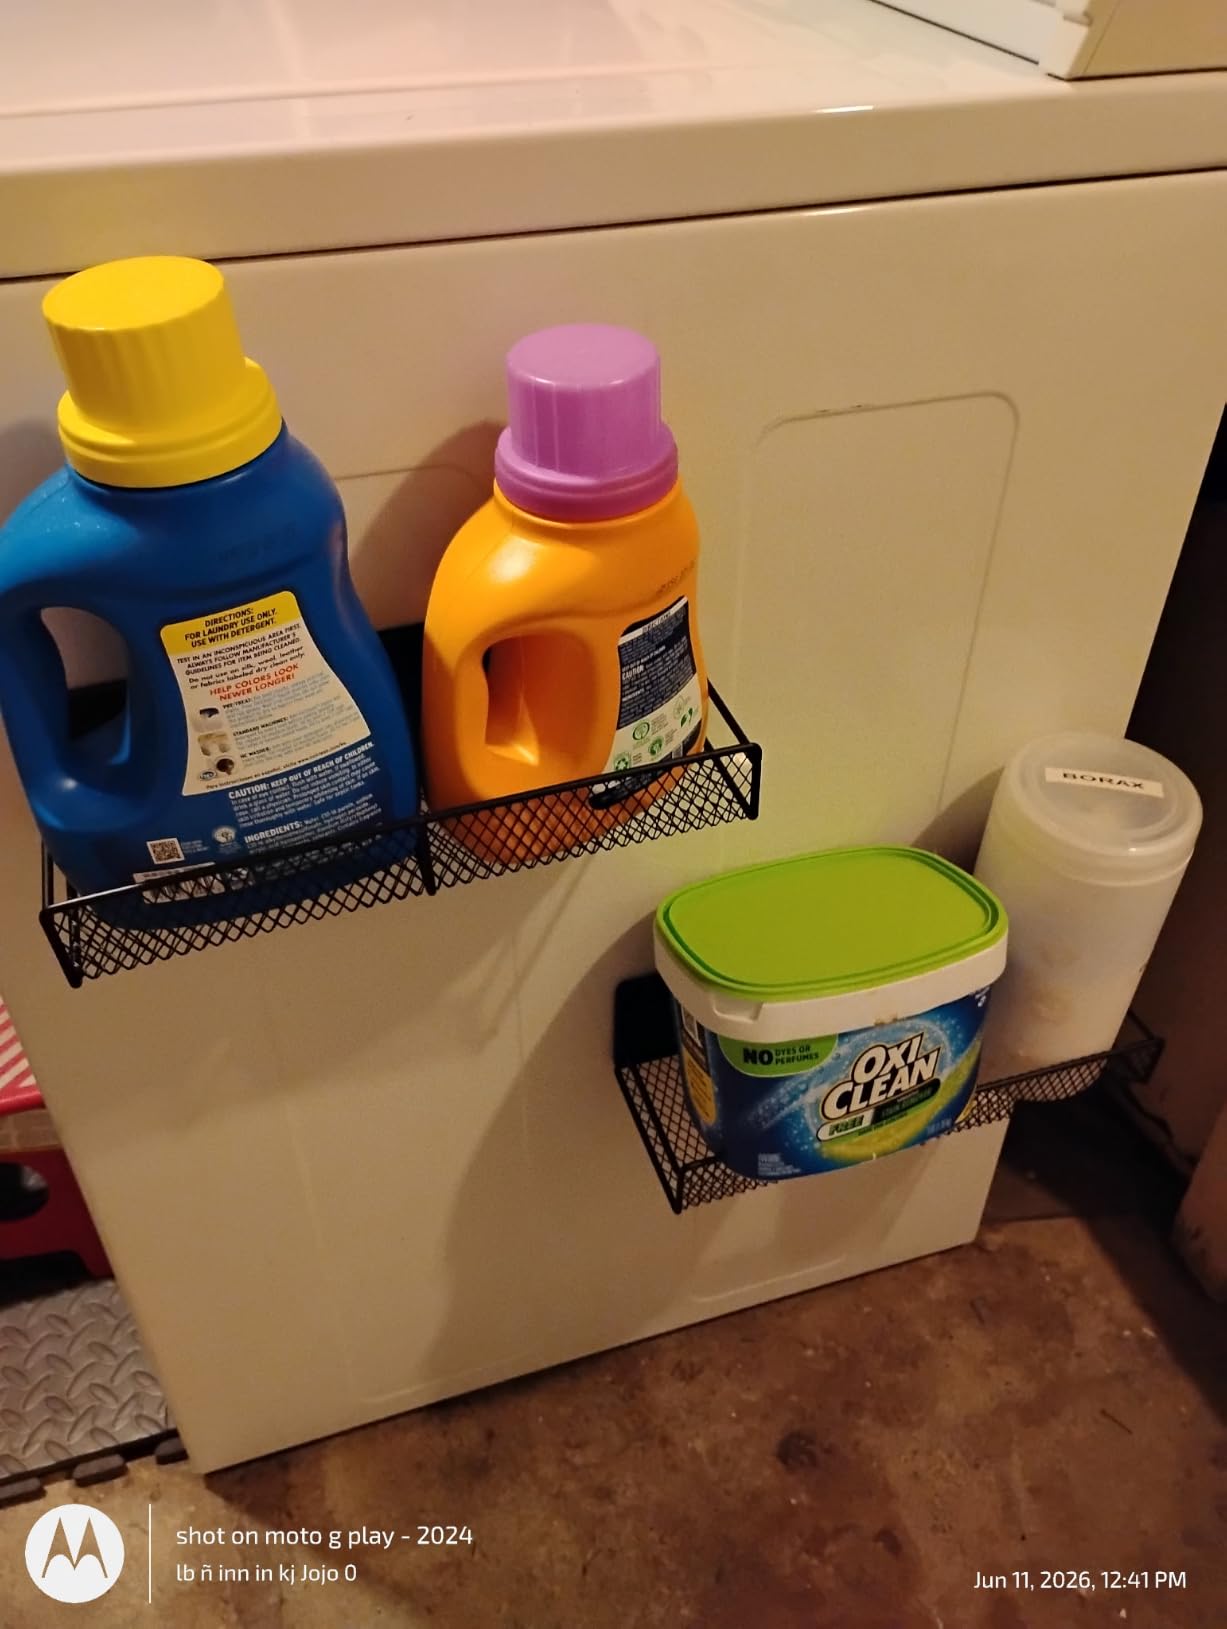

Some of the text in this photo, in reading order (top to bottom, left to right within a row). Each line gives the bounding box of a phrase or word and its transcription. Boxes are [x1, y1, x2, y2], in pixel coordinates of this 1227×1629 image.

[185, 608, 278, 641] FOR LAUNDRY USE ONLY.
[205, 608, 254, 628] DIRECTIONS:
[192, 618, 277, 648] USE WITH DETERGENT.
[215, 636, 266, 656] INCONSPICUOUS
[268, 630, 284, 639] AREA
[185, 662, 222, 676] GUIDELINES
[224, 659, 236, 667] FOR
[238, 655, 252, 663] ITEM
[254, 648, 272, 658] BEING
[188, 658, 213, 669] ALWAYS
[215, 650, 241, 662] FOLLOW
[210, 663, 299, 696] HELP COLORS LOOK
[219, 672, 295, 702] NEWER LONGER!
[228, 741, 375, 800] CAUTION: KEEP OUT OF REACH OF CHILDREN.
[1062, 772, 1145, 789] BORAX
[244, 820, 303, 843] INGREDIENTS:
[742, 1047, 774, 1066] NO
[775, 1044, 811, 1057] DYES OR
[775, 1052, 820, 1065] PERFUMES
[853, 1033, 923, 1085] OXI
[821, 1049, 940, 1120] CLEAN
[828, 1114, 865, 1137] FREE
